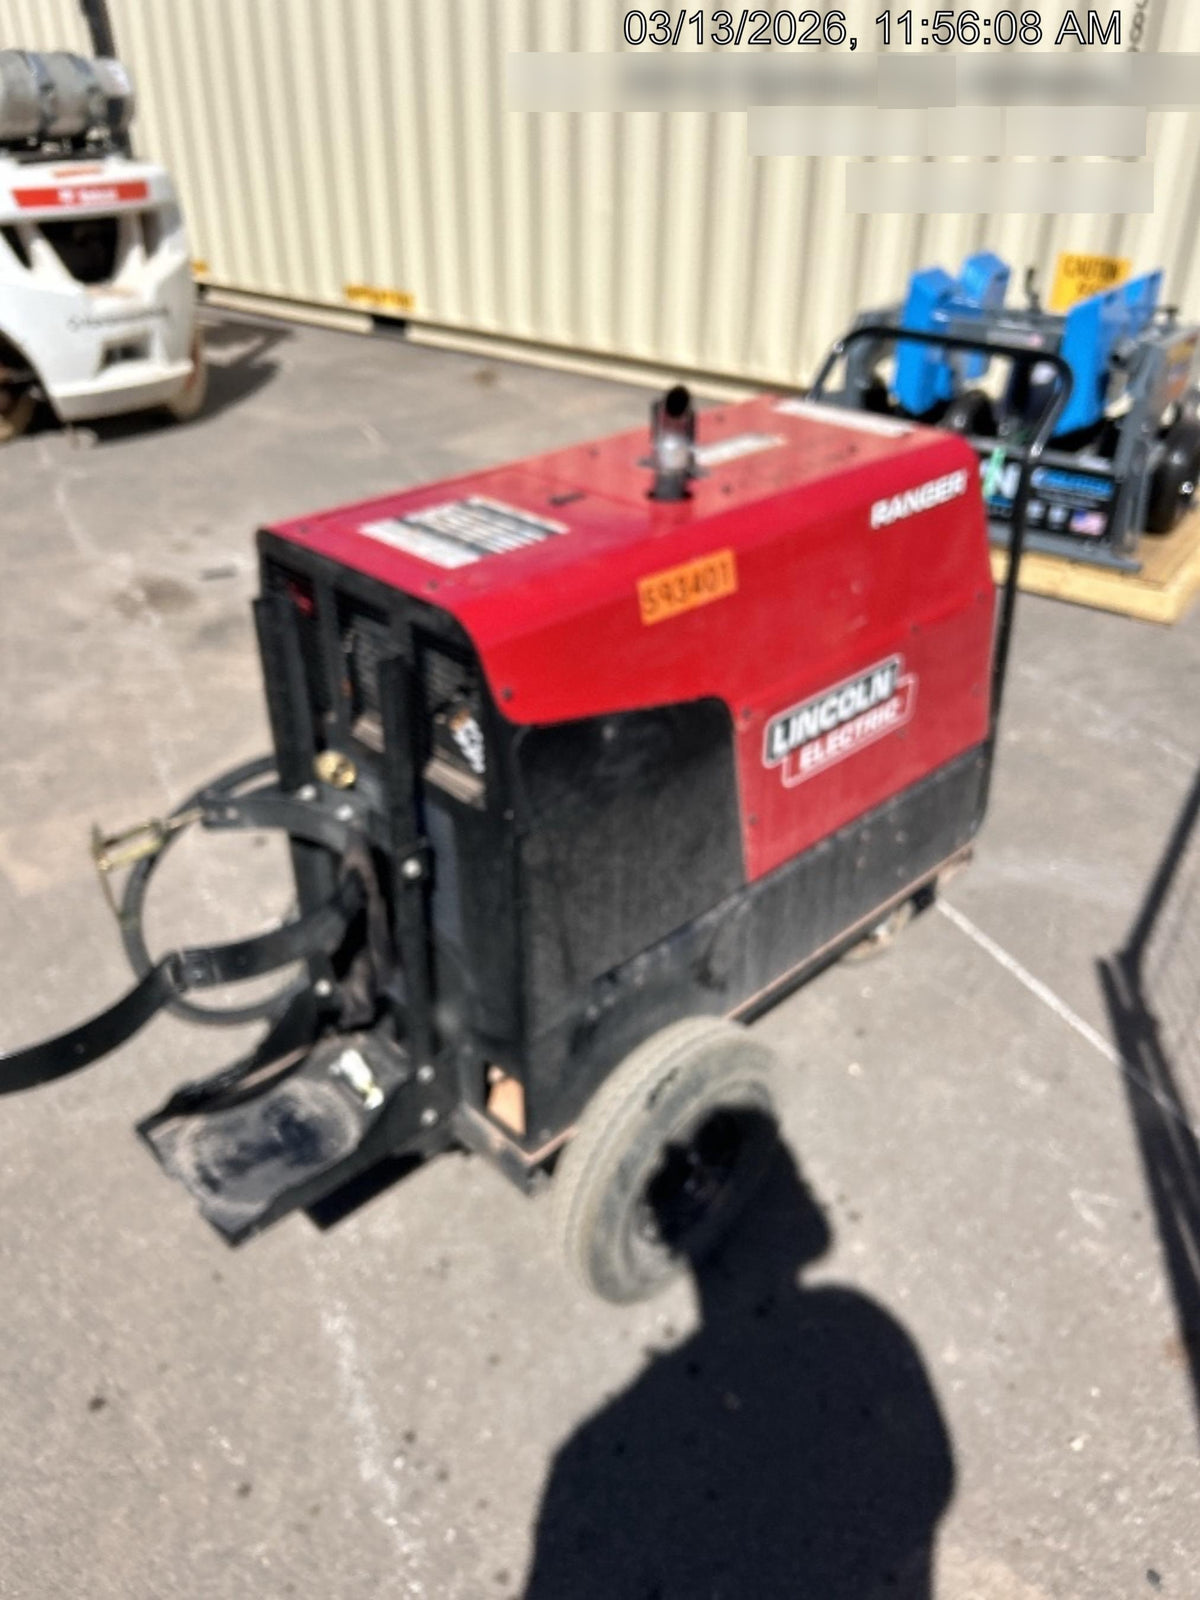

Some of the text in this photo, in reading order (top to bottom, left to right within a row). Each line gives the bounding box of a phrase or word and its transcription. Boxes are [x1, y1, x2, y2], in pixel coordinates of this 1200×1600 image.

[871, 468, 968, 530] RANGER
[643, 561, 729, 616] 593401
[772, 667, 895, 755] LINCOLN
[799, 695, 902, 772] ELECTRIC
